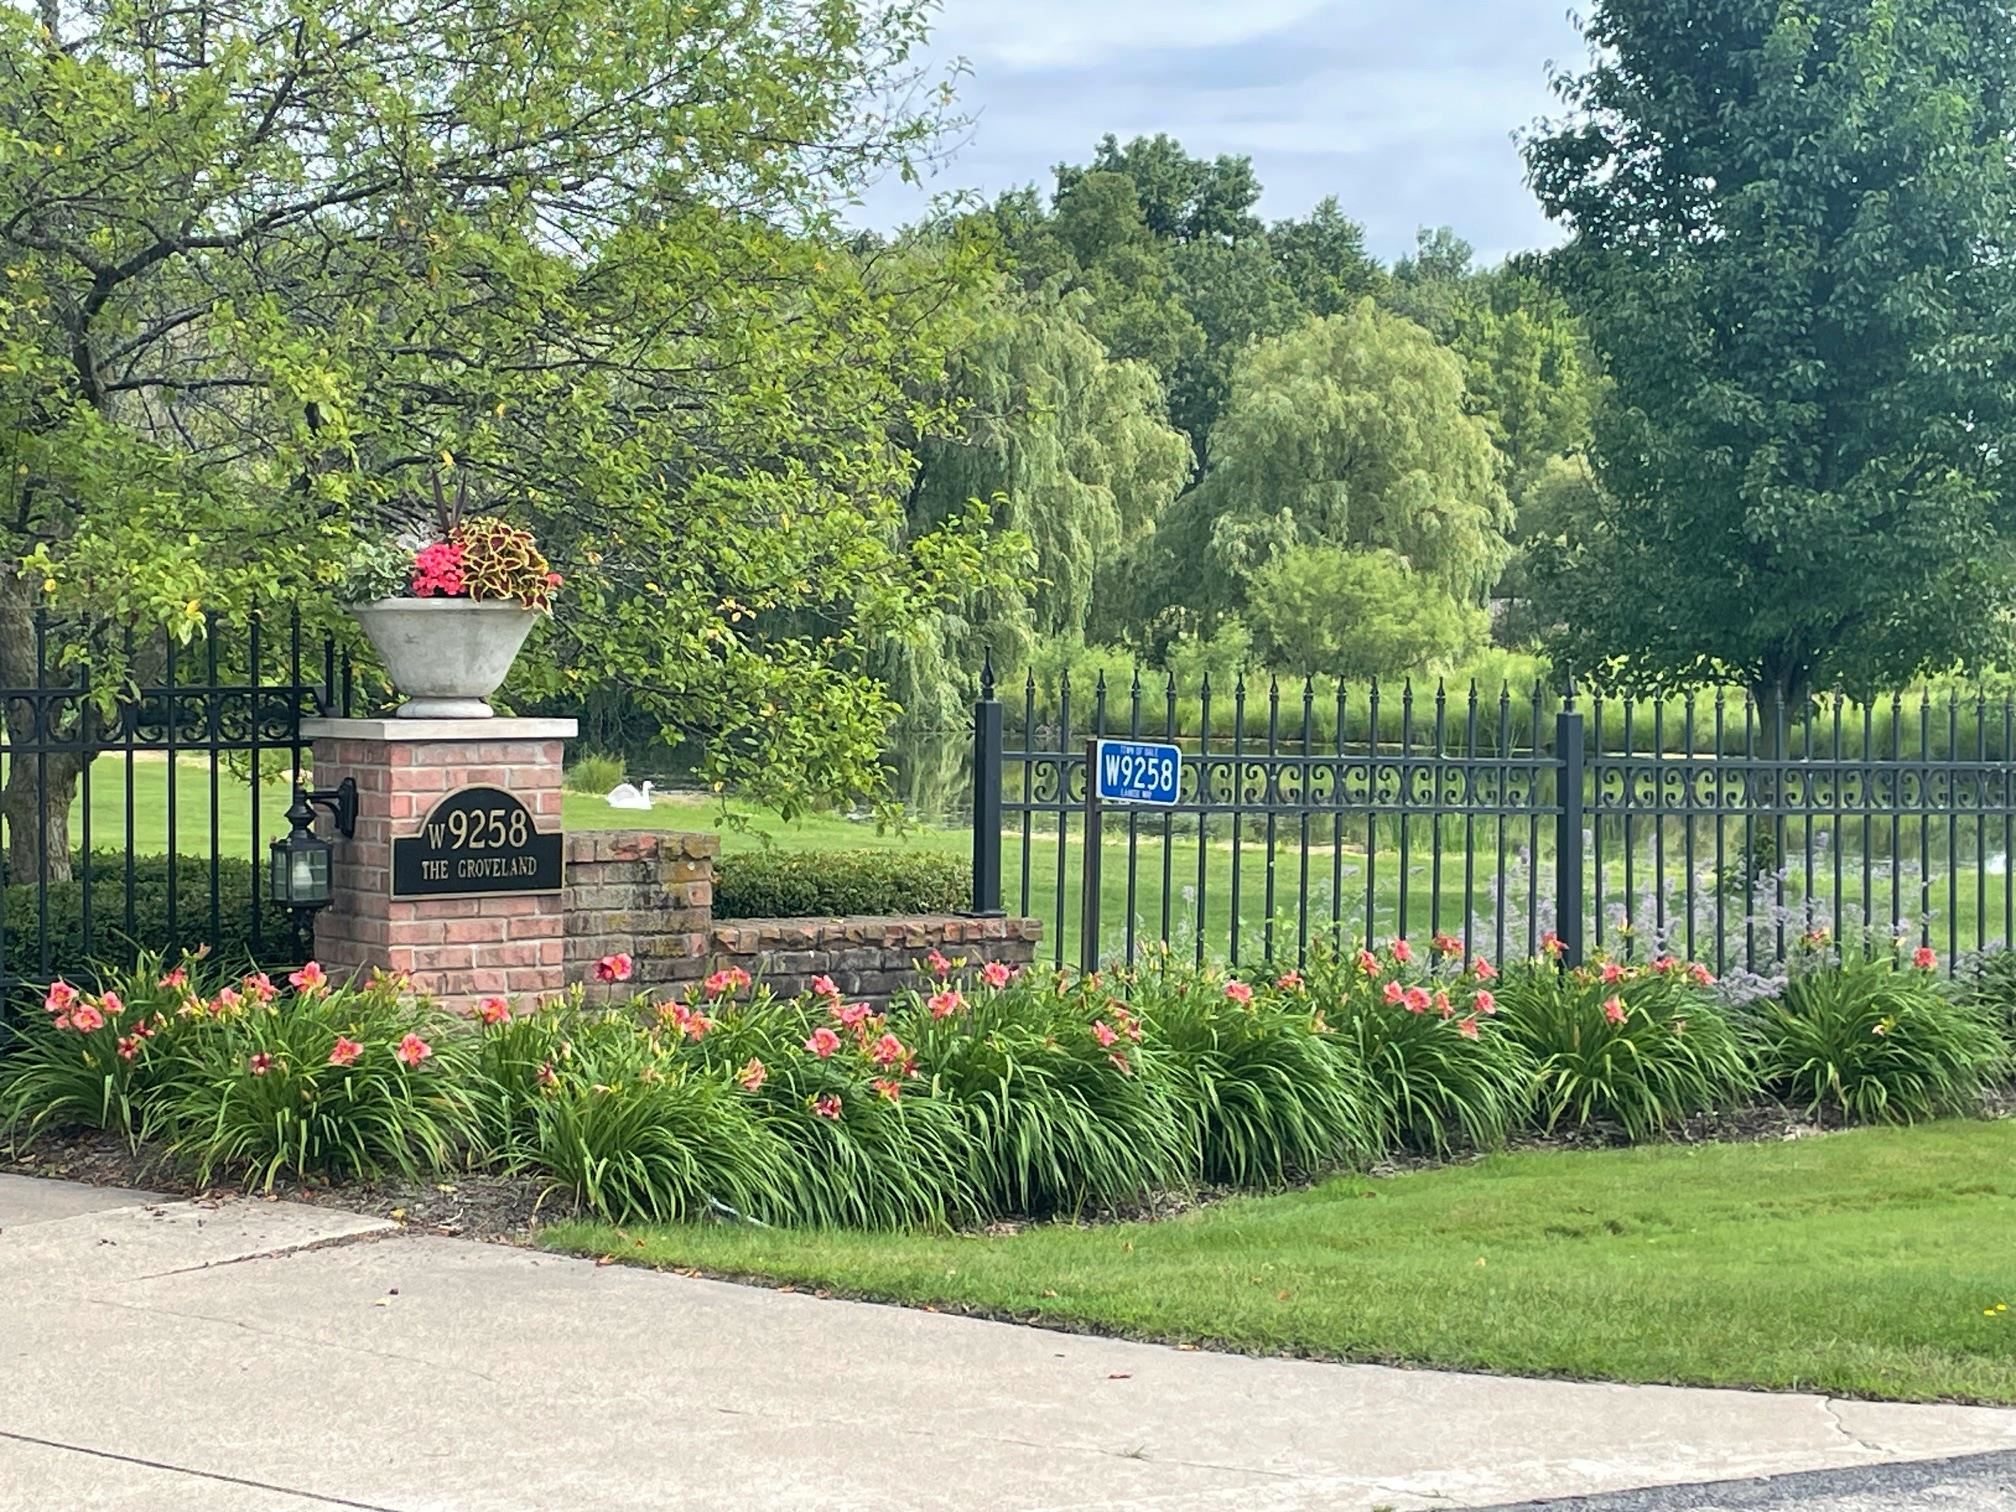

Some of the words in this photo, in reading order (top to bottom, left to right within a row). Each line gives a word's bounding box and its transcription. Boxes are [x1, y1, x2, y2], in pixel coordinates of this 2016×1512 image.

[1105, 754, 1173, 792] W9258
[421, 860, 449, 881] THE
[457, 856, 538, 879] GROVELAND
